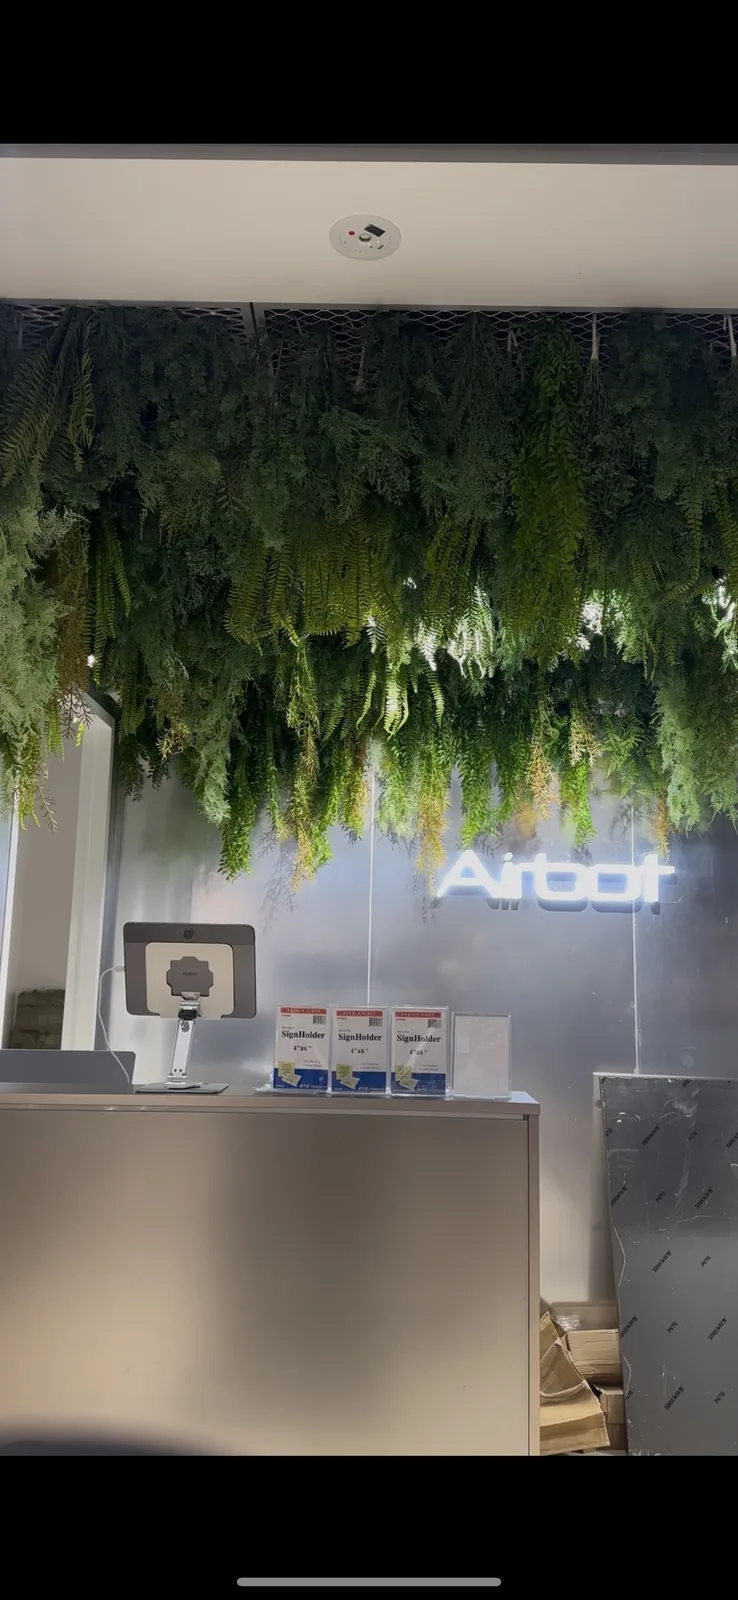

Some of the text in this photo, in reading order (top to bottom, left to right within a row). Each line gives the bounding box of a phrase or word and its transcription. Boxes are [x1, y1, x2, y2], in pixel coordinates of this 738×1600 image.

[436, 849, 675, 903] Airbot
[281, 1030, 325, 1039] SignHolder
[338, 1033, 382, 1042] SignHolder
[396, 1034, 441, 1043] SignHolder
